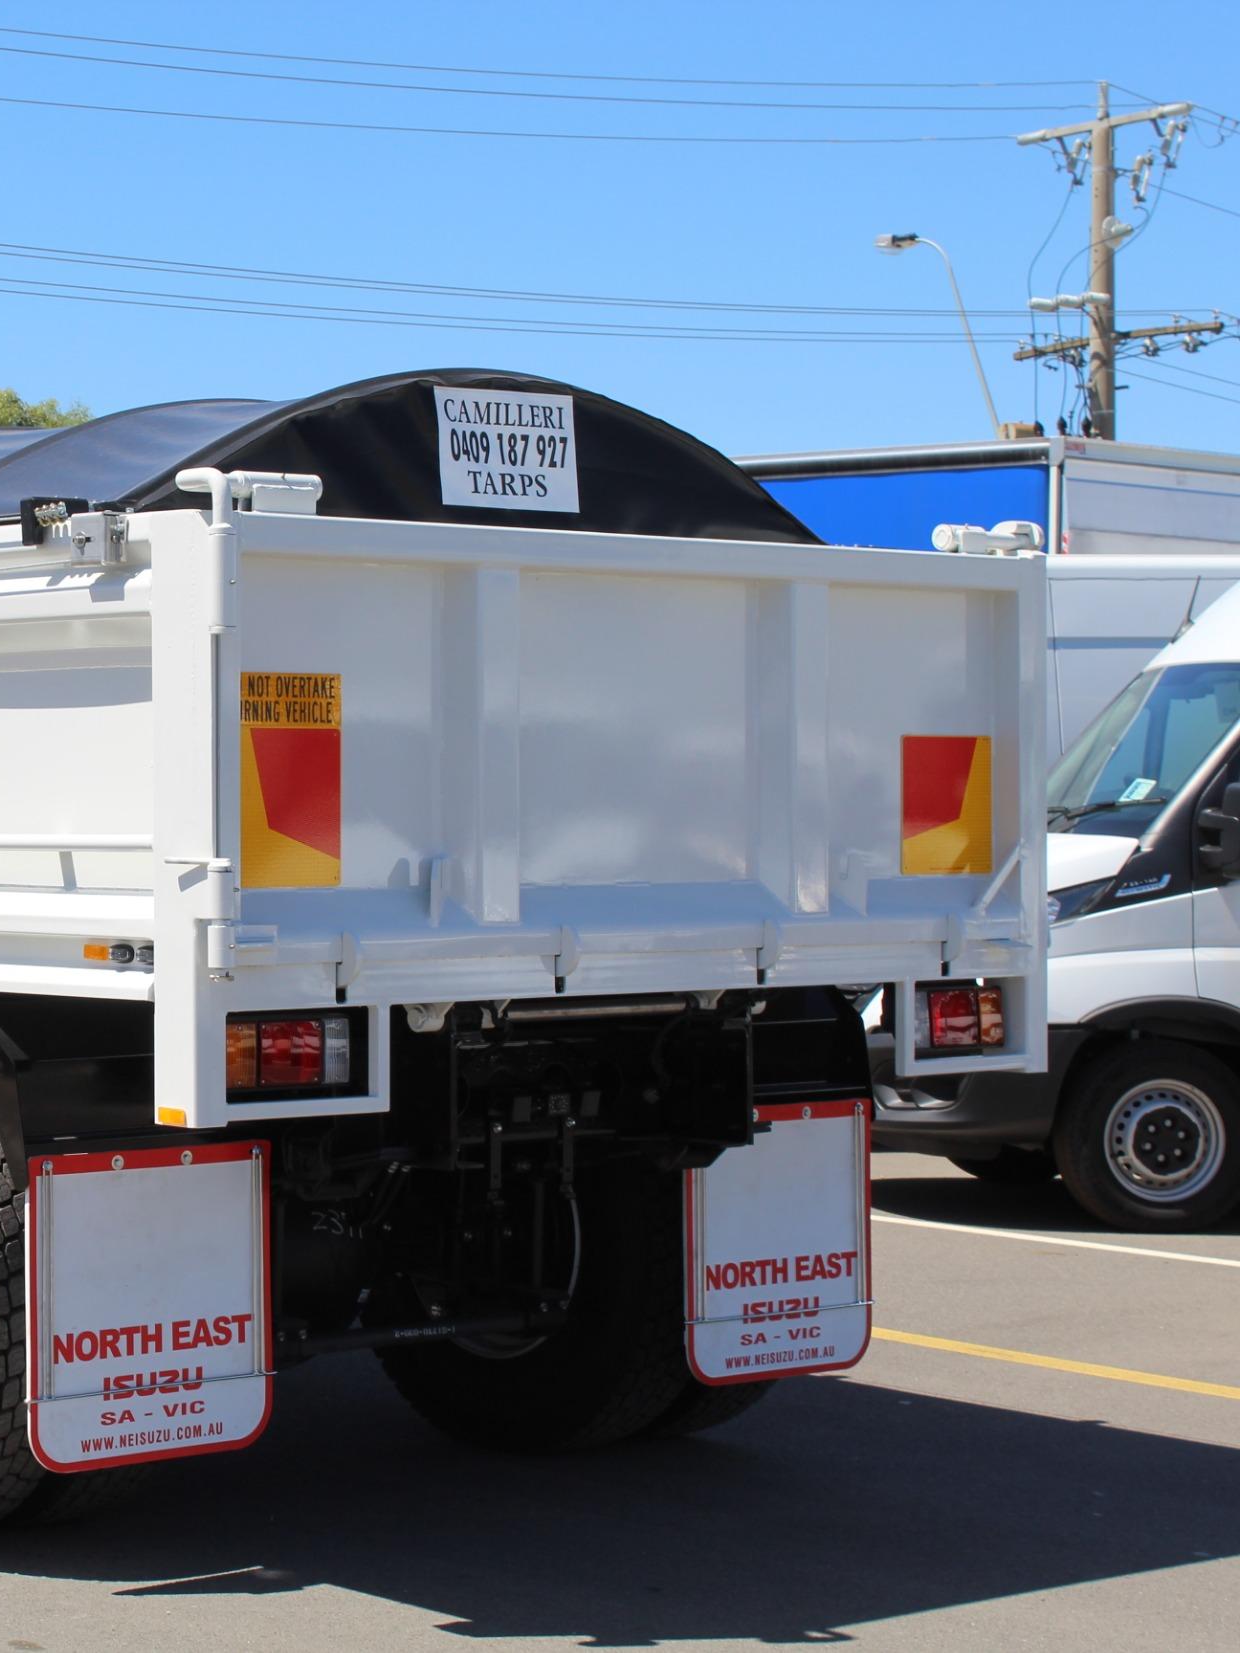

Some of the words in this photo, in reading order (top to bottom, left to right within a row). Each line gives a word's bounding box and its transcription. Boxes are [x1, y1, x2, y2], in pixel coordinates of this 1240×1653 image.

[443, 398, 566, 430] CAMILLERI
[450, 428, 490, 464] 0409
[497, 432, 530, 467] 187
[536, 434, 568, 469] 927
[467, 469, 548, 498] TARPS
[247, 675, 271, 698] NOT
[276, 675, 336, 699] OVERTAKE
[240, 699, 281, 722] RNING
[285, 700, 333, 724] VEHICLE
[705, 1257, 789, 1292] NORTH
[795, 1250, 858, 1282] EAST
[742, 1296, 820, 1325] ISUZU
[53, 1323, 163, 1365] NORTH
[171, 1313, 253, 1351] EAST
[740, 1332, 768, 1347] SA
[788, 1326, 822, 1341] VIC
[724, 1344, 836, 1370] WWW.NEISUZU.COM.AU
[103, 1366, 204, 1402] ISUZU
[100, 1409, 136, 1426] SA
[163, 1400, 205, 1418] VIC
[80, 1421, 224, 1453] WWW.NEISUZU.COM.AU
